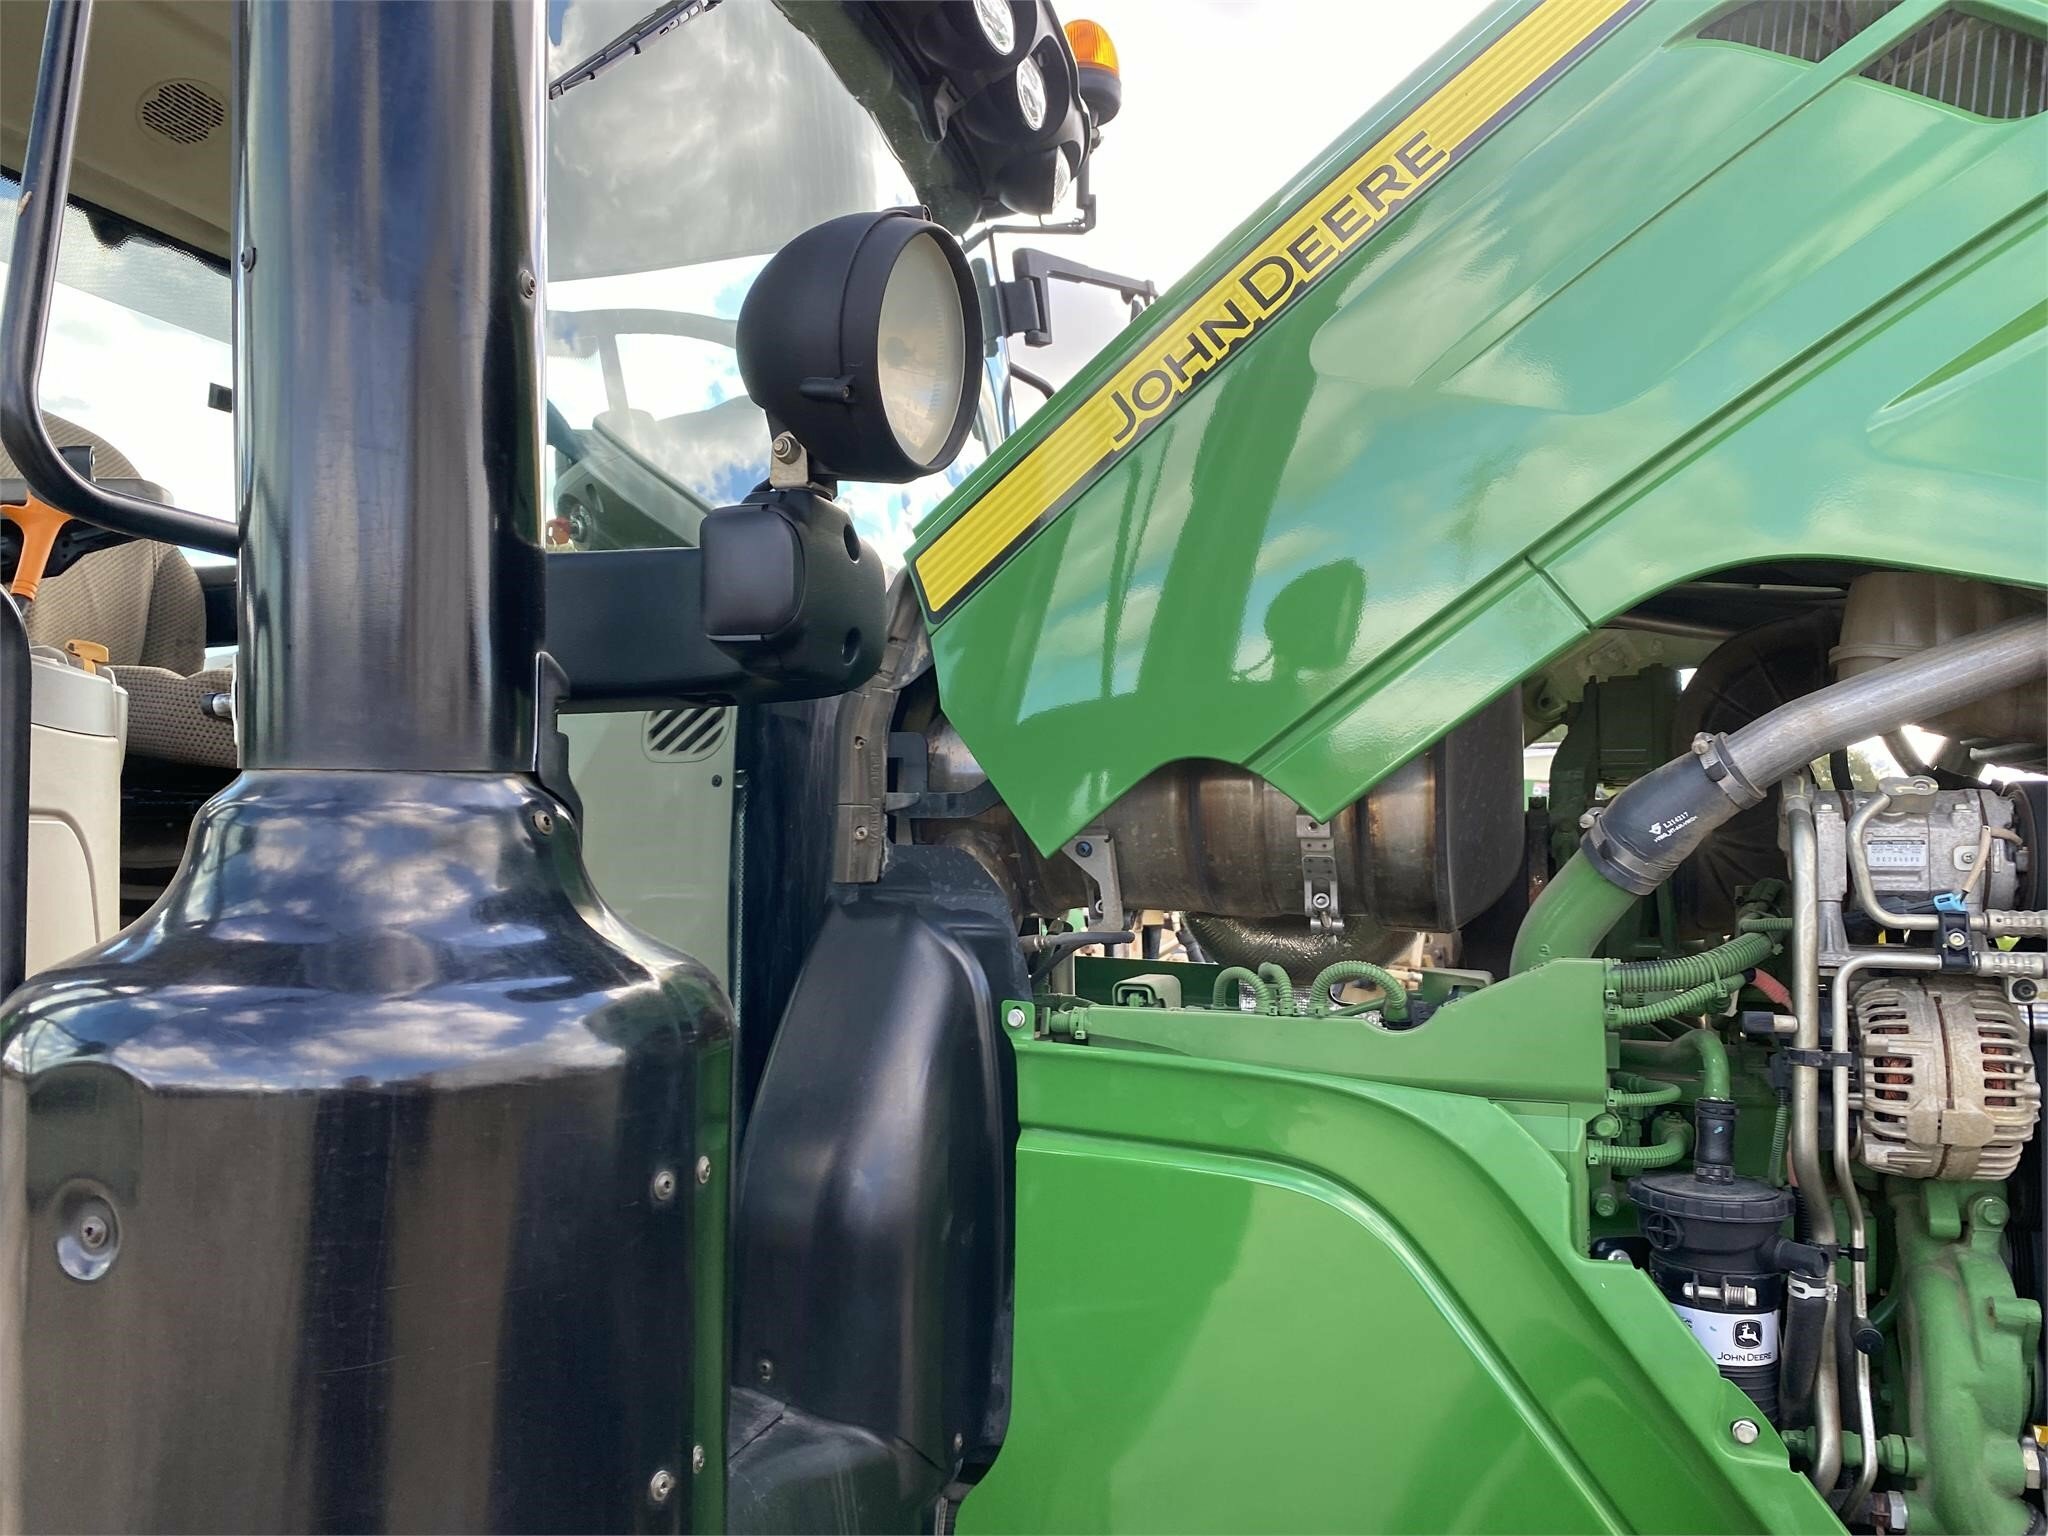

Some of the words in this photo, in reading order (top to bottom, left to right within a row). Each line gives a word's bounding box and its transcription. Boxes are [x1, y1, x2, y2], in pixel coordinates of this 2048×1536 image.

[1110, 298, 1252, 443] JOHN
[1238, 130, 1448, 311] DEERE
[1717, 1351, 1746, 1362] JOHN
[1746, 1351, 1772, 1362] DEERE
